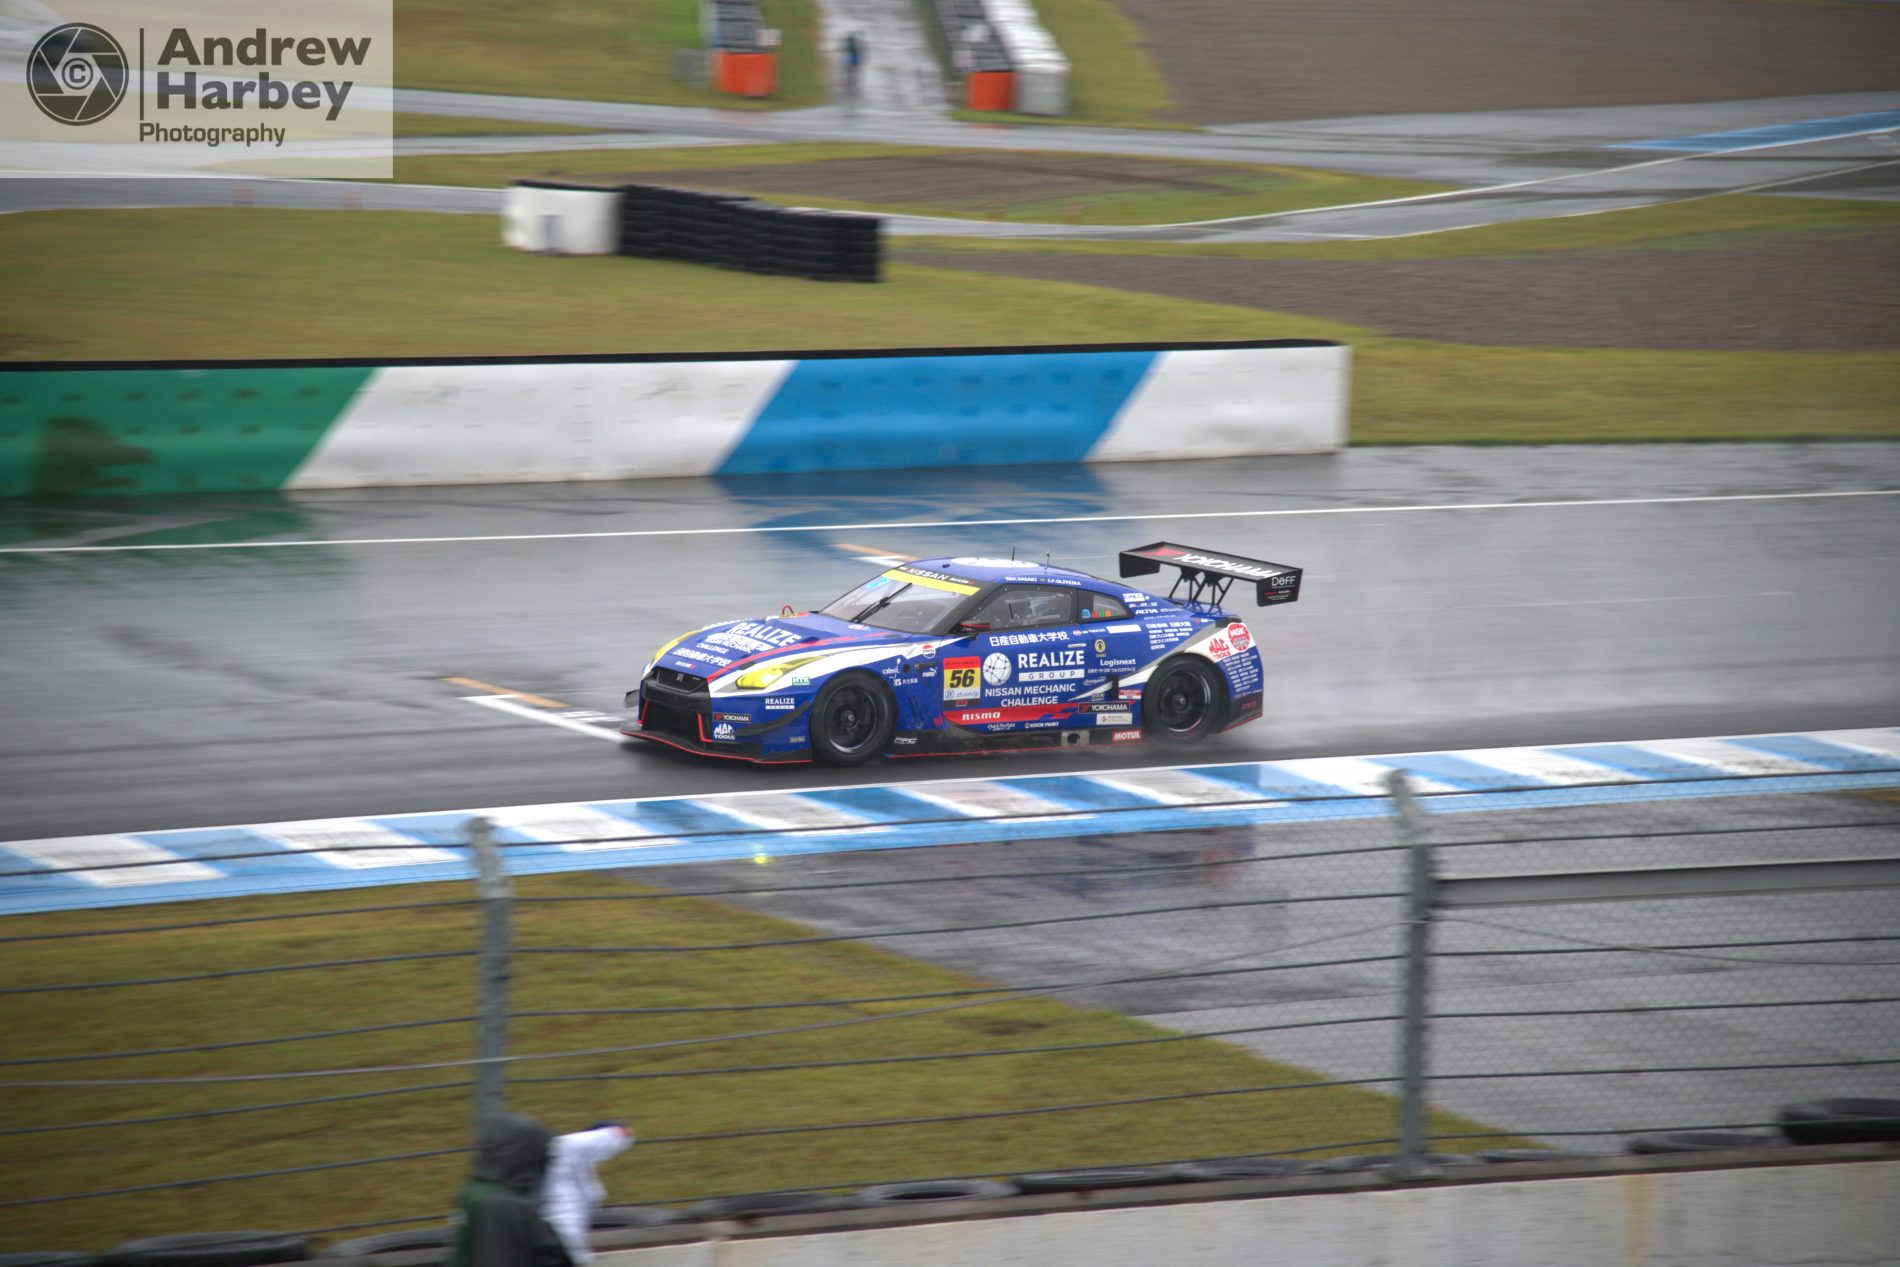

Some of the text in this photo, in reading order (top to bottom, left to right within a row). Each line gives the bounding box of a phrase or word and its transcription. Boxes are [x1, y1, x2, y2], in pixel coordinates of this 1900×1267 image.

[1173, 553, 1283, 578] YOKOHAMA
[906, 568, 950, 580] NISSAN
[725, 622, 803, 647] REALIZE
[989, 630, 1070, 647] 日産自動車大学校
[1018, 650, 1085, 668] REALIZE
[1100, 658, 1136, 667] Logisnext
[949, 668, 976, 689] 56
[1028, 670, 1076, 680] GROUP
[984, 683, 1076, 697] NISSAN MECHANIC
[765, 697, 795, 705] REALIZE
[1001, 695, 1059, 708] CHALLENGE
[1091, 703, 1128, 712] YOKOHAMA
[723, 714, 750, 722] YOKOHAMA
[962, 711, 1001, 721] nismo
[1113, 731, 1141, 741] MOTUL
